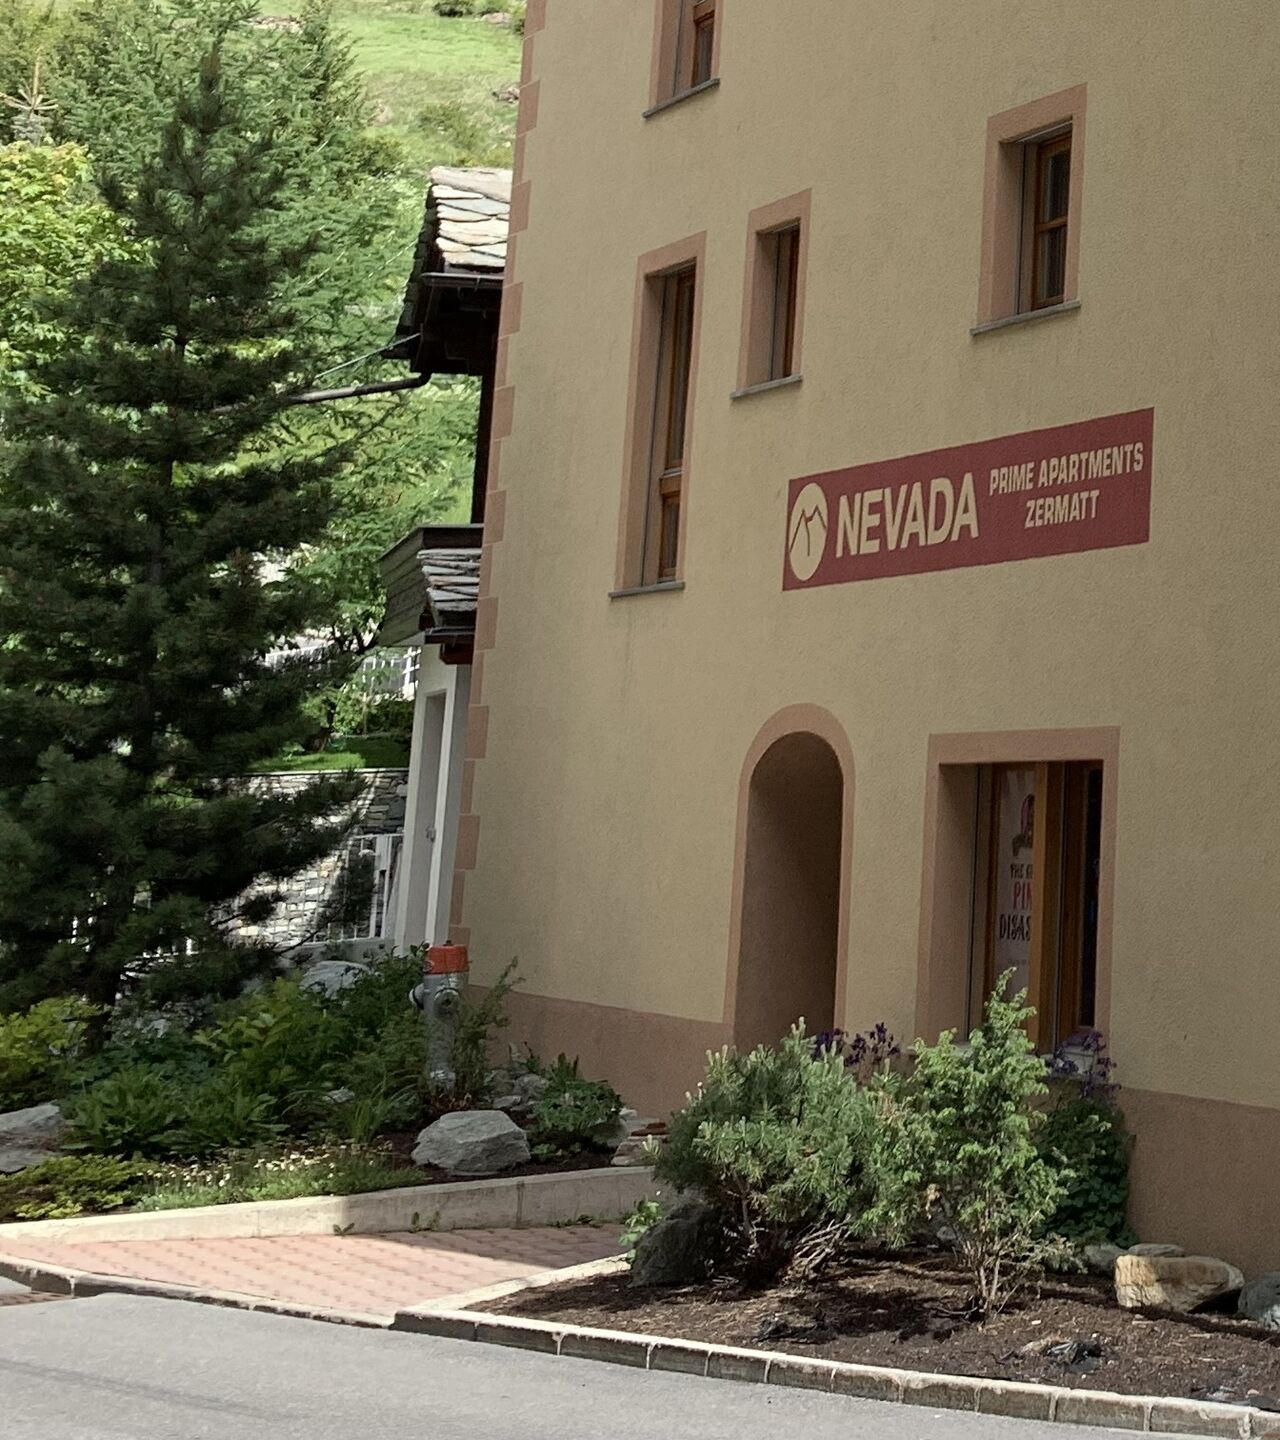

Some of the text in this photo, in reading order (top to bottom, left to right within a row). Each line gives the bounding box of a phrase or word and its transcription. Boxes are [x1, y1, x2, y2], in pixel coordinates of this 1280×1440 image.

[989, 442, 1144, 496] PRIME APARTMENTS
[836, 472, 979, 558] NEVADA
[1024, 489, 1100, 529] ZERMATT
